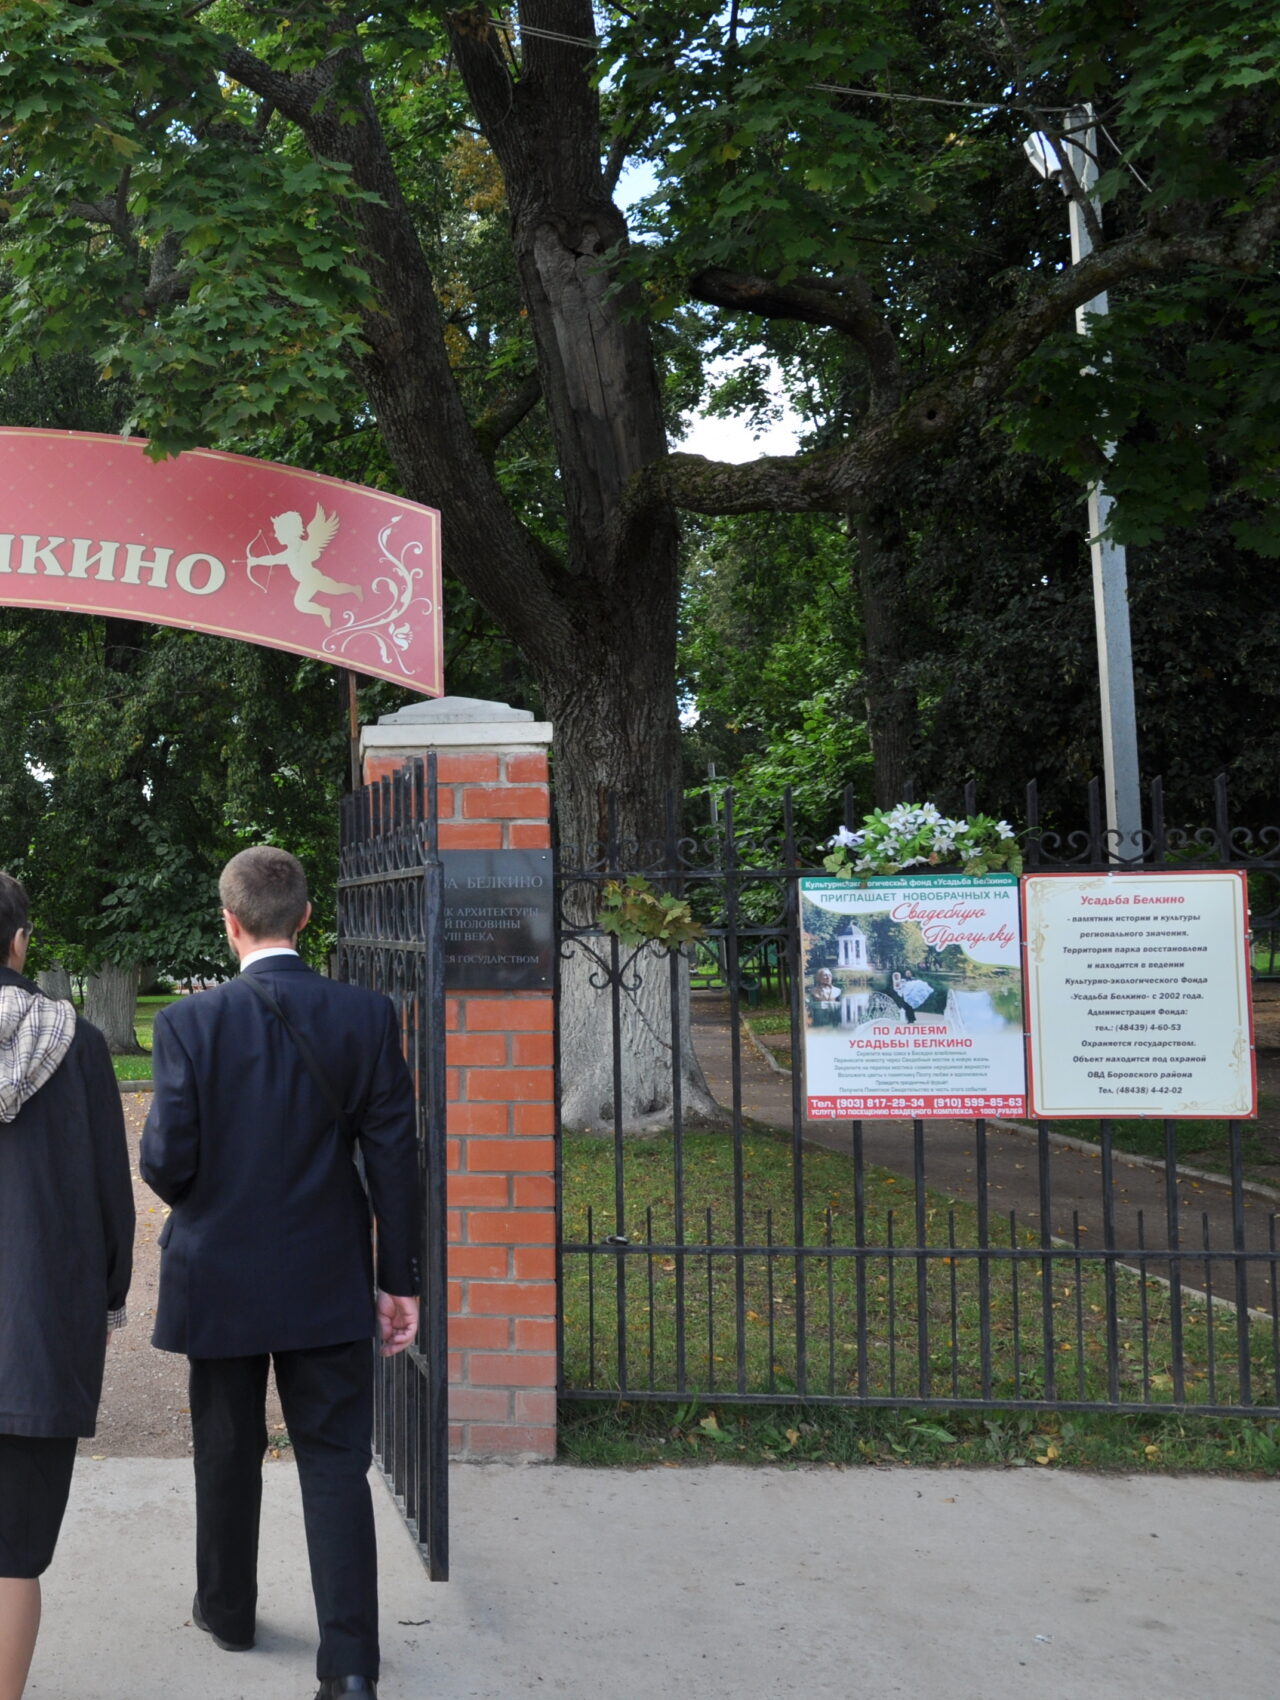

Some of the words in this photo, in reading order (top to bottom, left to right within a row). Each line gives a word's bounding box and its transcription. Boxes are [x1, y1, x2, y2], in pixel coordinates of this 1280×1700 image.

[467, 875, 543, 889] БЕЛКИНО
[909, 878, 932, 889] фонд
[820, 892, 896, 903] ПРИГЛАШАЕТ
[903, 891, 991, 901] НОВОБРАЧНЫХ
[994, 890, 1010, 900] НА
[1080, 895, 1130, 906] Усадьба
[1133, 894, 1185, 905] Белкино
[457, 906, 538, 917] АРХИТЕКТУРЫ
[892, 901, 986, 926] Свадебную
[1072, 915, 1113, 923] памятник
[1115, 915, 1151, 923] истории
[1161, 914, 1201, 923] культуры
[456, 919, 520, 929] ПОЛОВИНЫ
[464, 932, 495, 941] ВЕКА
[923, 923, 1016, 949] Прогулку
[1079, 930, 1144, 939] регионального
[1062, 946, 1113, 955] Территория
[1143, 945, 1208, 953] восстановлена
[457, 955, 539, 965] ГОСУДАРСТВОМ
[1095, 962, 1139, 970] находится
[1065, 976, 1179, 986] Культурно-экологического
[1180, 976, 1208, 985] Фонда
[1182, 993, 1204, 1001] года.
[1087, 1008, 1156, 1017] Администрация
[1157, 1007, 1189, 1016] Фонда:
[873, 1026, 890, 1036] ПО
[894, 1025, 947, 1036] АЛЛЕЯМ
[1115, 1023, 1148, 1033] (48439)
[1150, 1023, 1182, 1031] 4-60-53
[849, 1039, 909, 1050] УСАДЬБЫ
[914, 1038, 973, 1049] БЕЛКИНО
[1081, 1039, 1132, 1048] Охраняется
[1133, 1040, 1197, 1049] государством.
[1072, 1055, 1104, 1063] Объект
[1169, 1054, 1207, 1063] охраной
[1087, 1071, 1105, 1079] ОВД
[1107, 1071, 1159, 1079] Боровского
[1160, 1070, 1193, 1079] района
[1098, 1086, 1114, 1094] Тел.
[1115, 1086, 1149, 1095] (48438)
[1150, 1086, 1183, 1094] 4-42-02
[811, 1099, 834, 1108] Тел.
[837, 1098, 864, 1109] (903)
[934, 1097, 962, 1108] (910)
